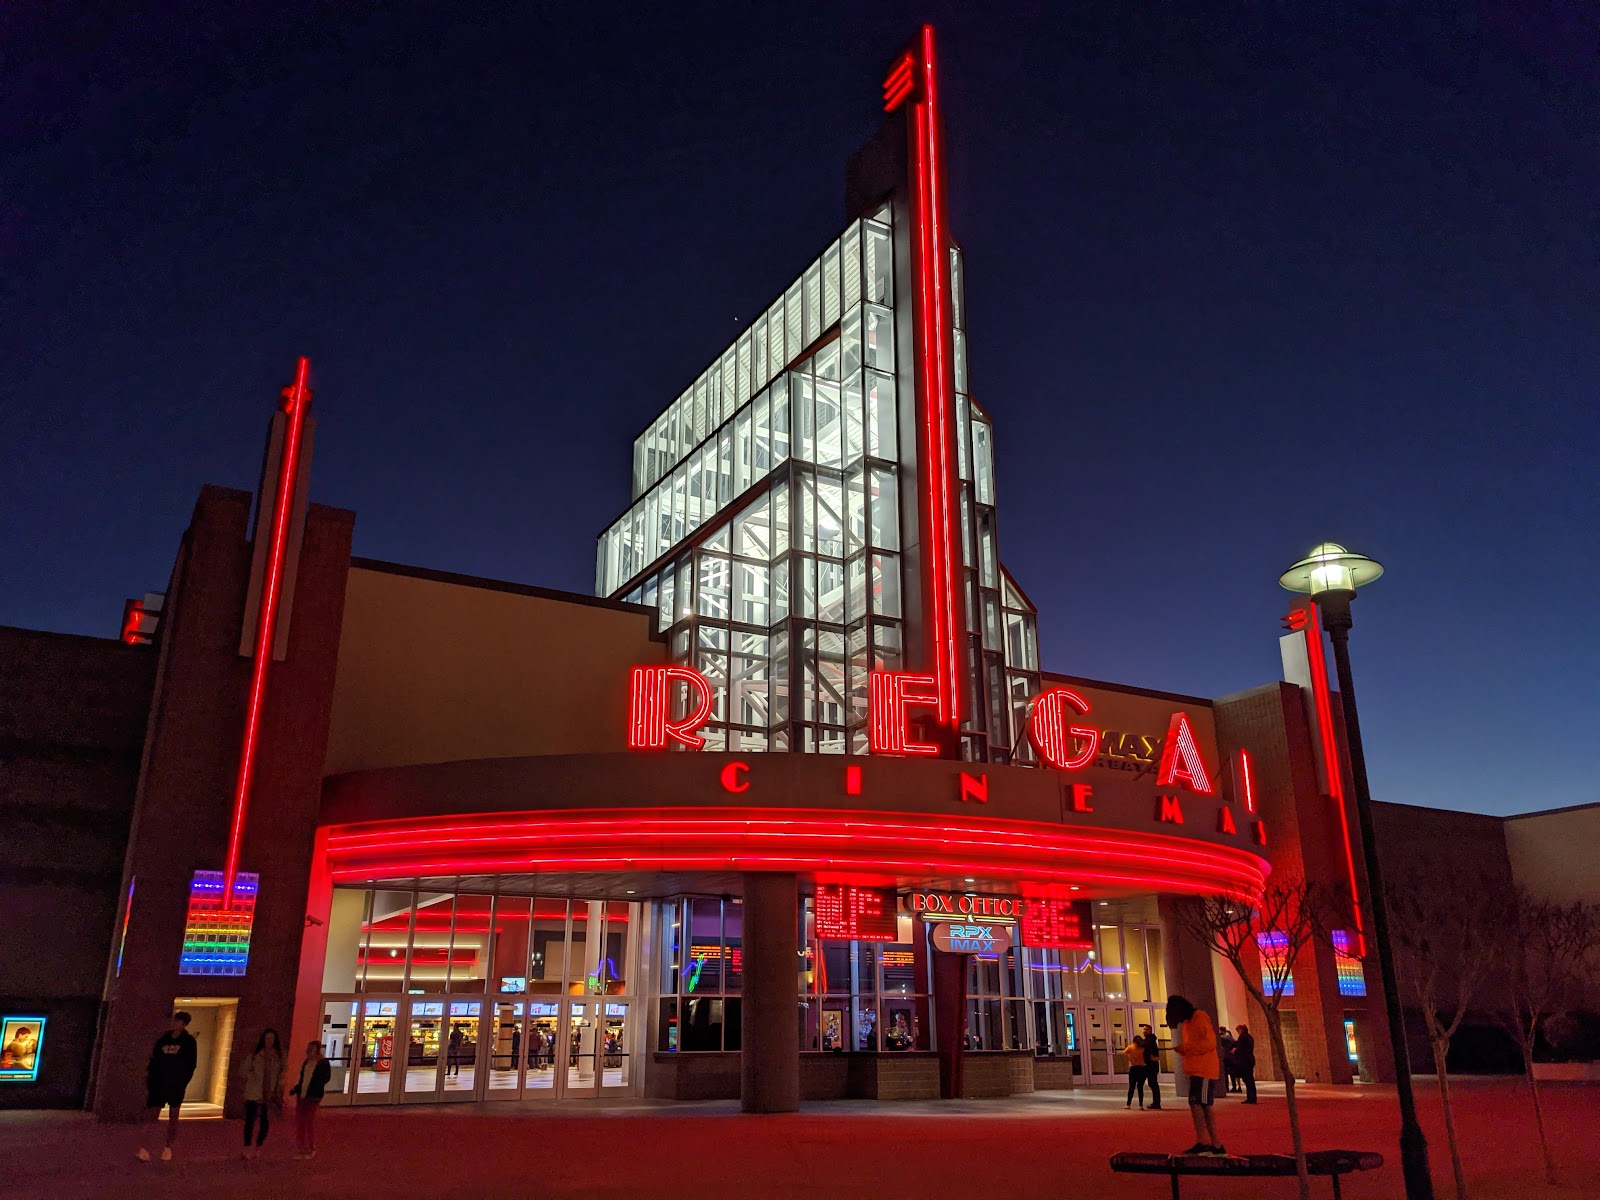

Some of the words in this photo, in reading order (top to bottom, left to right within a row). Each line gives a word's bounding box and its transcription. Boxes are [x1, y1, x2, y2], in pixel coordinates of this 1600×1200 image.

[721, 761, 1267, 846] CINEMAS
[913, 893, 954, 912] BOX
[958, 897, 1024, 917] OFFICE
[949, 924, 993, 938] RPX
[949, 939, 995, 951] IMAX
